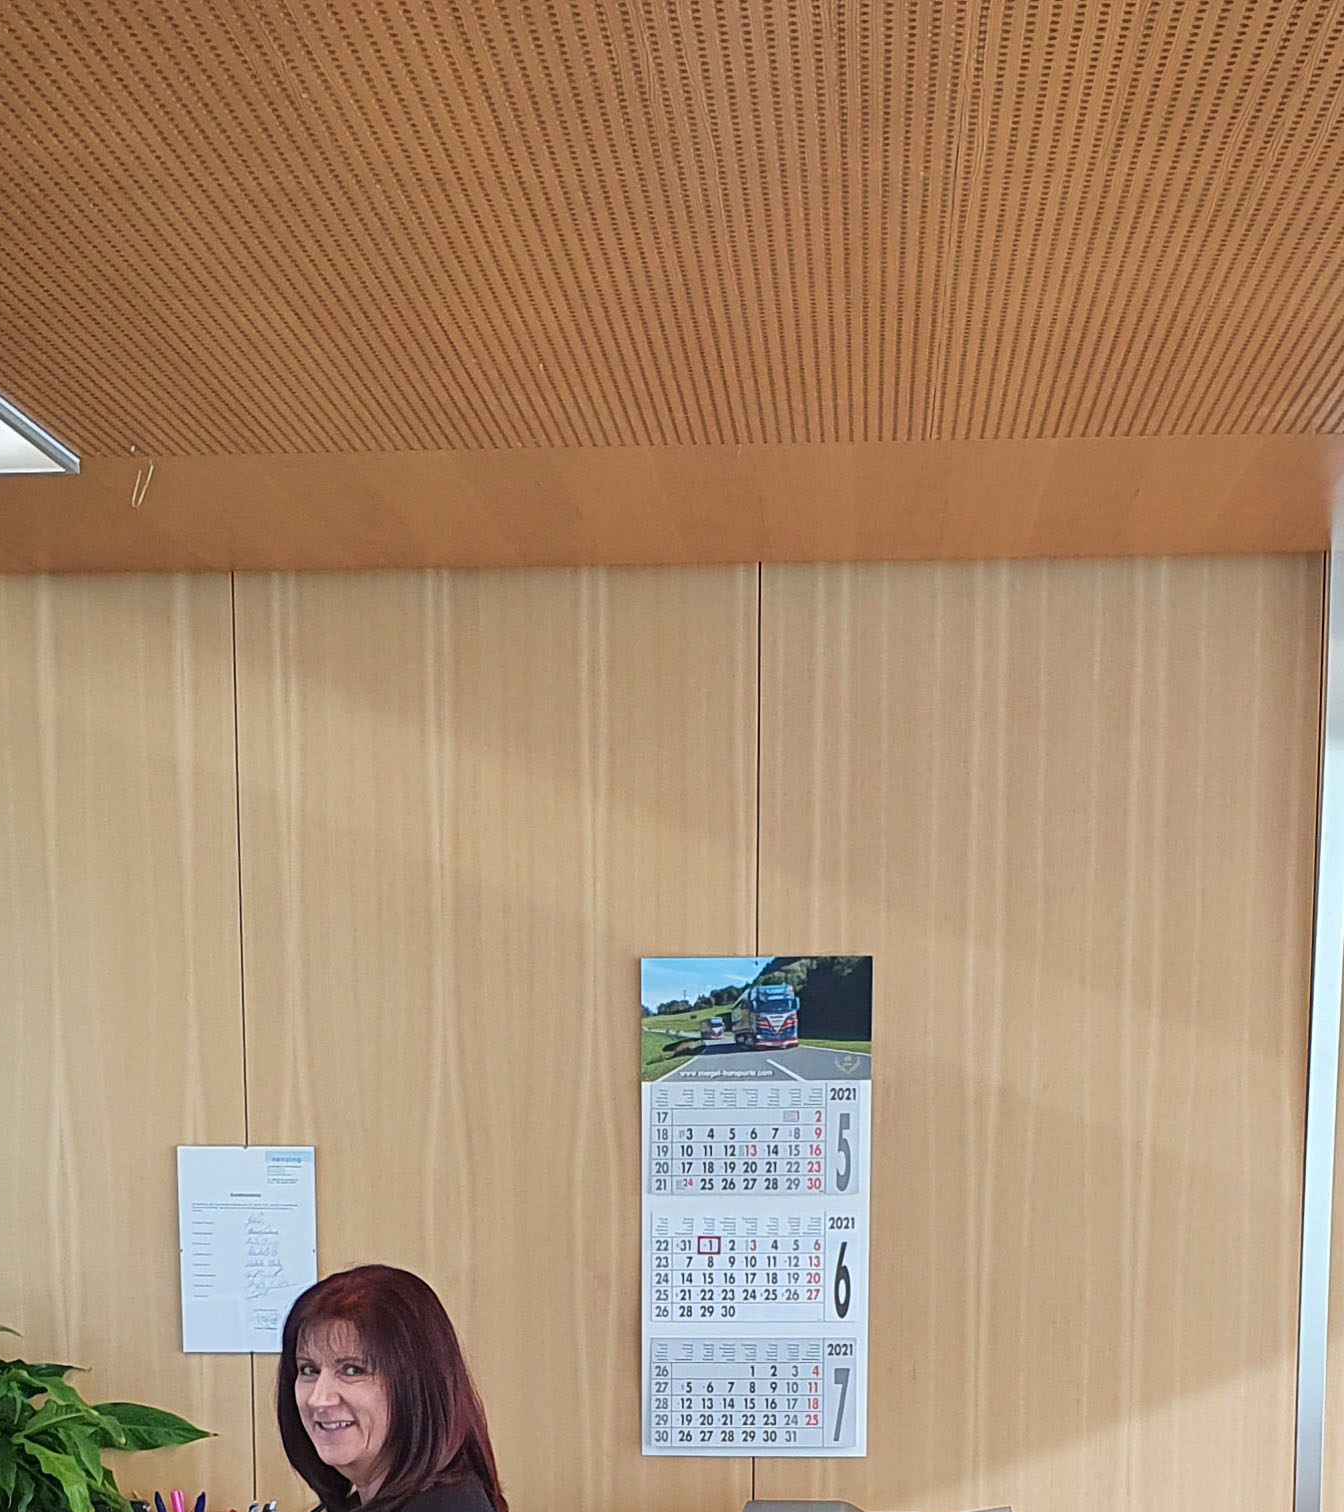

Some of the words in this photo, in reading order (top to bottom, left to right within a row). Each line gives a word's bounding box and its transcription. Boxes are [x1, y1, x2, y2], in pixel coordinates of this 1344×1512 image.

[830, 1088, 857, 1101] 2021
[657, 1112, 668, 1123] 17
[796, 1111, 800, 1121] 1
[815, 1111, 822, 1122] 2
[657, 1129, 669, 1140] 18
[686, 1128, 693, 1140] 3
[707, 1128, 714, 1140] 4
[729, 1128, 736, 1140] 5
[750, 1128, 758, 1140] 6
[772, 1128, 779, 1140] 7
[794, 1128, 801, 1139] 8
[815, 1127, 822, 1139] 9
[657, 1146, 669, 1157] 19
[681, 1145, 693, 1157] 10
[703, 1145, 713, 1157] 11
[724, 1145, 736, 1157] 12
[746, 1145, 757, 1157] 13
[767, 1145, 779, 1157] 14
[788, 1145, 800, 1157] 15
[809, 1145, 821, 1156] 16
[836, 1113, 851, 1191] 5
[655, 1162, 669, 1174] 20
[682, 1162, 693, 1173] 17
[703, 1162, 714, 1173] 18
[724, 1162, 736, 1173] 19
[743, 1162, 758, 1173] 20
[765, 1162, 777, 1173] 21
[786, 1162, 800, 1173] 22
[807, 1161, 821, 1173] 23
[655, 1179, 667, 1191] 21
[683, 1179, 693, 1188] 24
[700, 1179, 714, 1190] 25
[721, 1179, 736, 1190] 26
[743, 1179, 757, 1190] 27
[764, 1179, 779, 1190] 28
[786, 1179, 800, 1190] 29
[807, 1178, 821, 1189] 30
[829, 1217, 855, 1229] 2021
[655, 1240, 669, 1251] 22
[680, 1240, 691, 1251] 31
[709, 1240, 713, 1251] 1
[728, 1240, 736, 1251] 2
[750, 1240, 757, 1251] 3
[771, 1240, 779, 1251] 4
[793, 1240, 799, 1251] 5
[813, 1240, 821, 1251] 6
[655, 1257, 669, 1268] 23
[686, 1257, 693, 1268] 7
[707, 1257, 714, 1268] 8
[728, 1257, 736, 1268] 9
[744, 1257, 757, 1268] 10
[766, 1257, 777, 1268] 11
[787, 1257, 800, 1268] 12
[809, 1257, 821, 1268] 13
[655, 1273, 669, 1284] 24
[681, 1273, 693, 1284] 14
[702, 1273, 714, 1284] 15
[723, 1273, 736, 1284] 16
[745, 1273, 756, 1284] 17
[766, 1273, 778, 1284] 18
[787, 1273, 800, 1284] 19
[806, 1273, 821, 1284] 20
[834, 1242, 851, 1319] 6
[655, 1289, 669, 1301] 25
[679, 1289, 691, 1301] 21
[700, 1289, 714, 1301] 22
[721, 1289, 735, 1301] 23
[742, 1289, 757, 1301] 24
[763, 1289, 778, 1301] 25
[785, 1289, 800, 1301] 26
[807, 1289, 820, 1301] 27
[655, 1306, 669, 1318] 26
[679, 1306, 693, 1318] 28
[700, 1306, 714, 1318] 29
[721, 1306, 735, 1318] 30
[827, 1344, 853, 1356] 2021
[655, 1366, 669, 1377] 26
[750, 1366, 755, 1377] 1
[770, 1366, 778, 1377] 2
[792, 1366, 799, 1377] 3
[812, 1366, 820, 1377] 4
[655, 1382, 669, 1393] 27
[686, 1382, 693, 1393] 5
[707, 1382, 714, 1393] 6
[728, 1382, 735, 1393] 7
[749, 1382, 756, 1393] 8
[770, 1382, 777, 1393] 9
[787, 1382, 799, 1393] 10
[808, 1382, 819, 1393] 11
[655, 1398, 669, 1410] 28
[680, 1398, 693, 1410] 12
[702, 1398, 713, 1410] 13
[723, 1398, 735, 1410] 14
[744, 1398, 756, 1410] 15
[765, 1398, 777, 1410] 16
[786, 1398, 798, 1410] 17
[807, 1398, 819, 1410] 18
[833, 1368, 850, 1442] 7
[655, 1414, 669, 1426] 29
[680, 1414, 693, 1426] 19
[699, 1414, 714, 1426] 20
[721, 1414, 733, 1426] 21
[742, 1414, 756, 1426] 22
[763, 1414, 777, 1426] 23
[784, 1414, 799, 1426] 24
[805, 1414, 819, 1426] 25
[655, 1431, 669, 1442] 30
[678, 1431, 693, 1442] 26
[700, 1431, 713, 1442] 27
[720, 1431, 735, 1442] 28
[742, 1431, 756, 1442] 29
[762, 1431, 777, 1442] 30
[785, 1431, 797, 1442] 31
